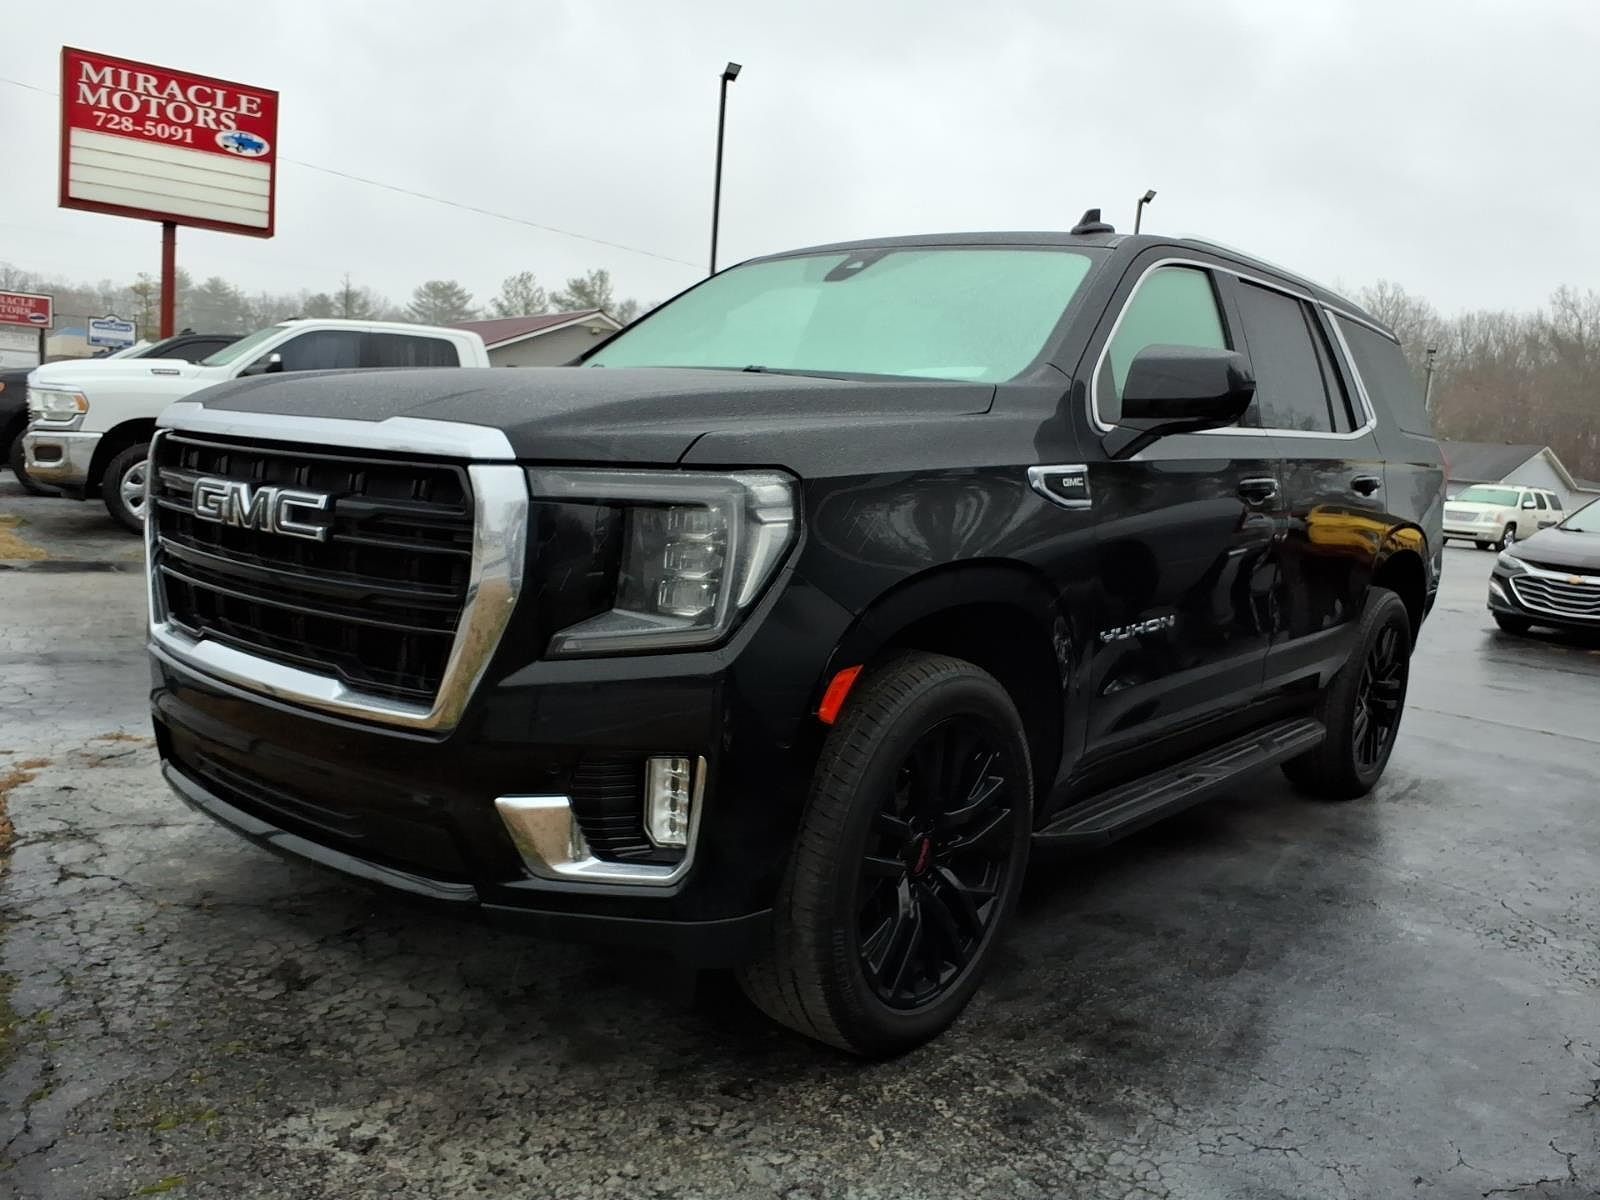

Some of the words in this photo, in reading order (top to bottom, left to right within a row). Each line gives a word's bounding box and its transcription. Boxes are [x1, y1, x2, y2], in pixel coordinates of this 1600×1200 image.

[76, 83, 237, 131] MOTORS
[78, 61, 262, 117] MIRACLE
[93, 111, 194, 143] 728-5091
[1062, 477, 1084, 487] GMC
[193, 477, 328, 541] GMC
[1100, 615, 1175, 643] YUKON
